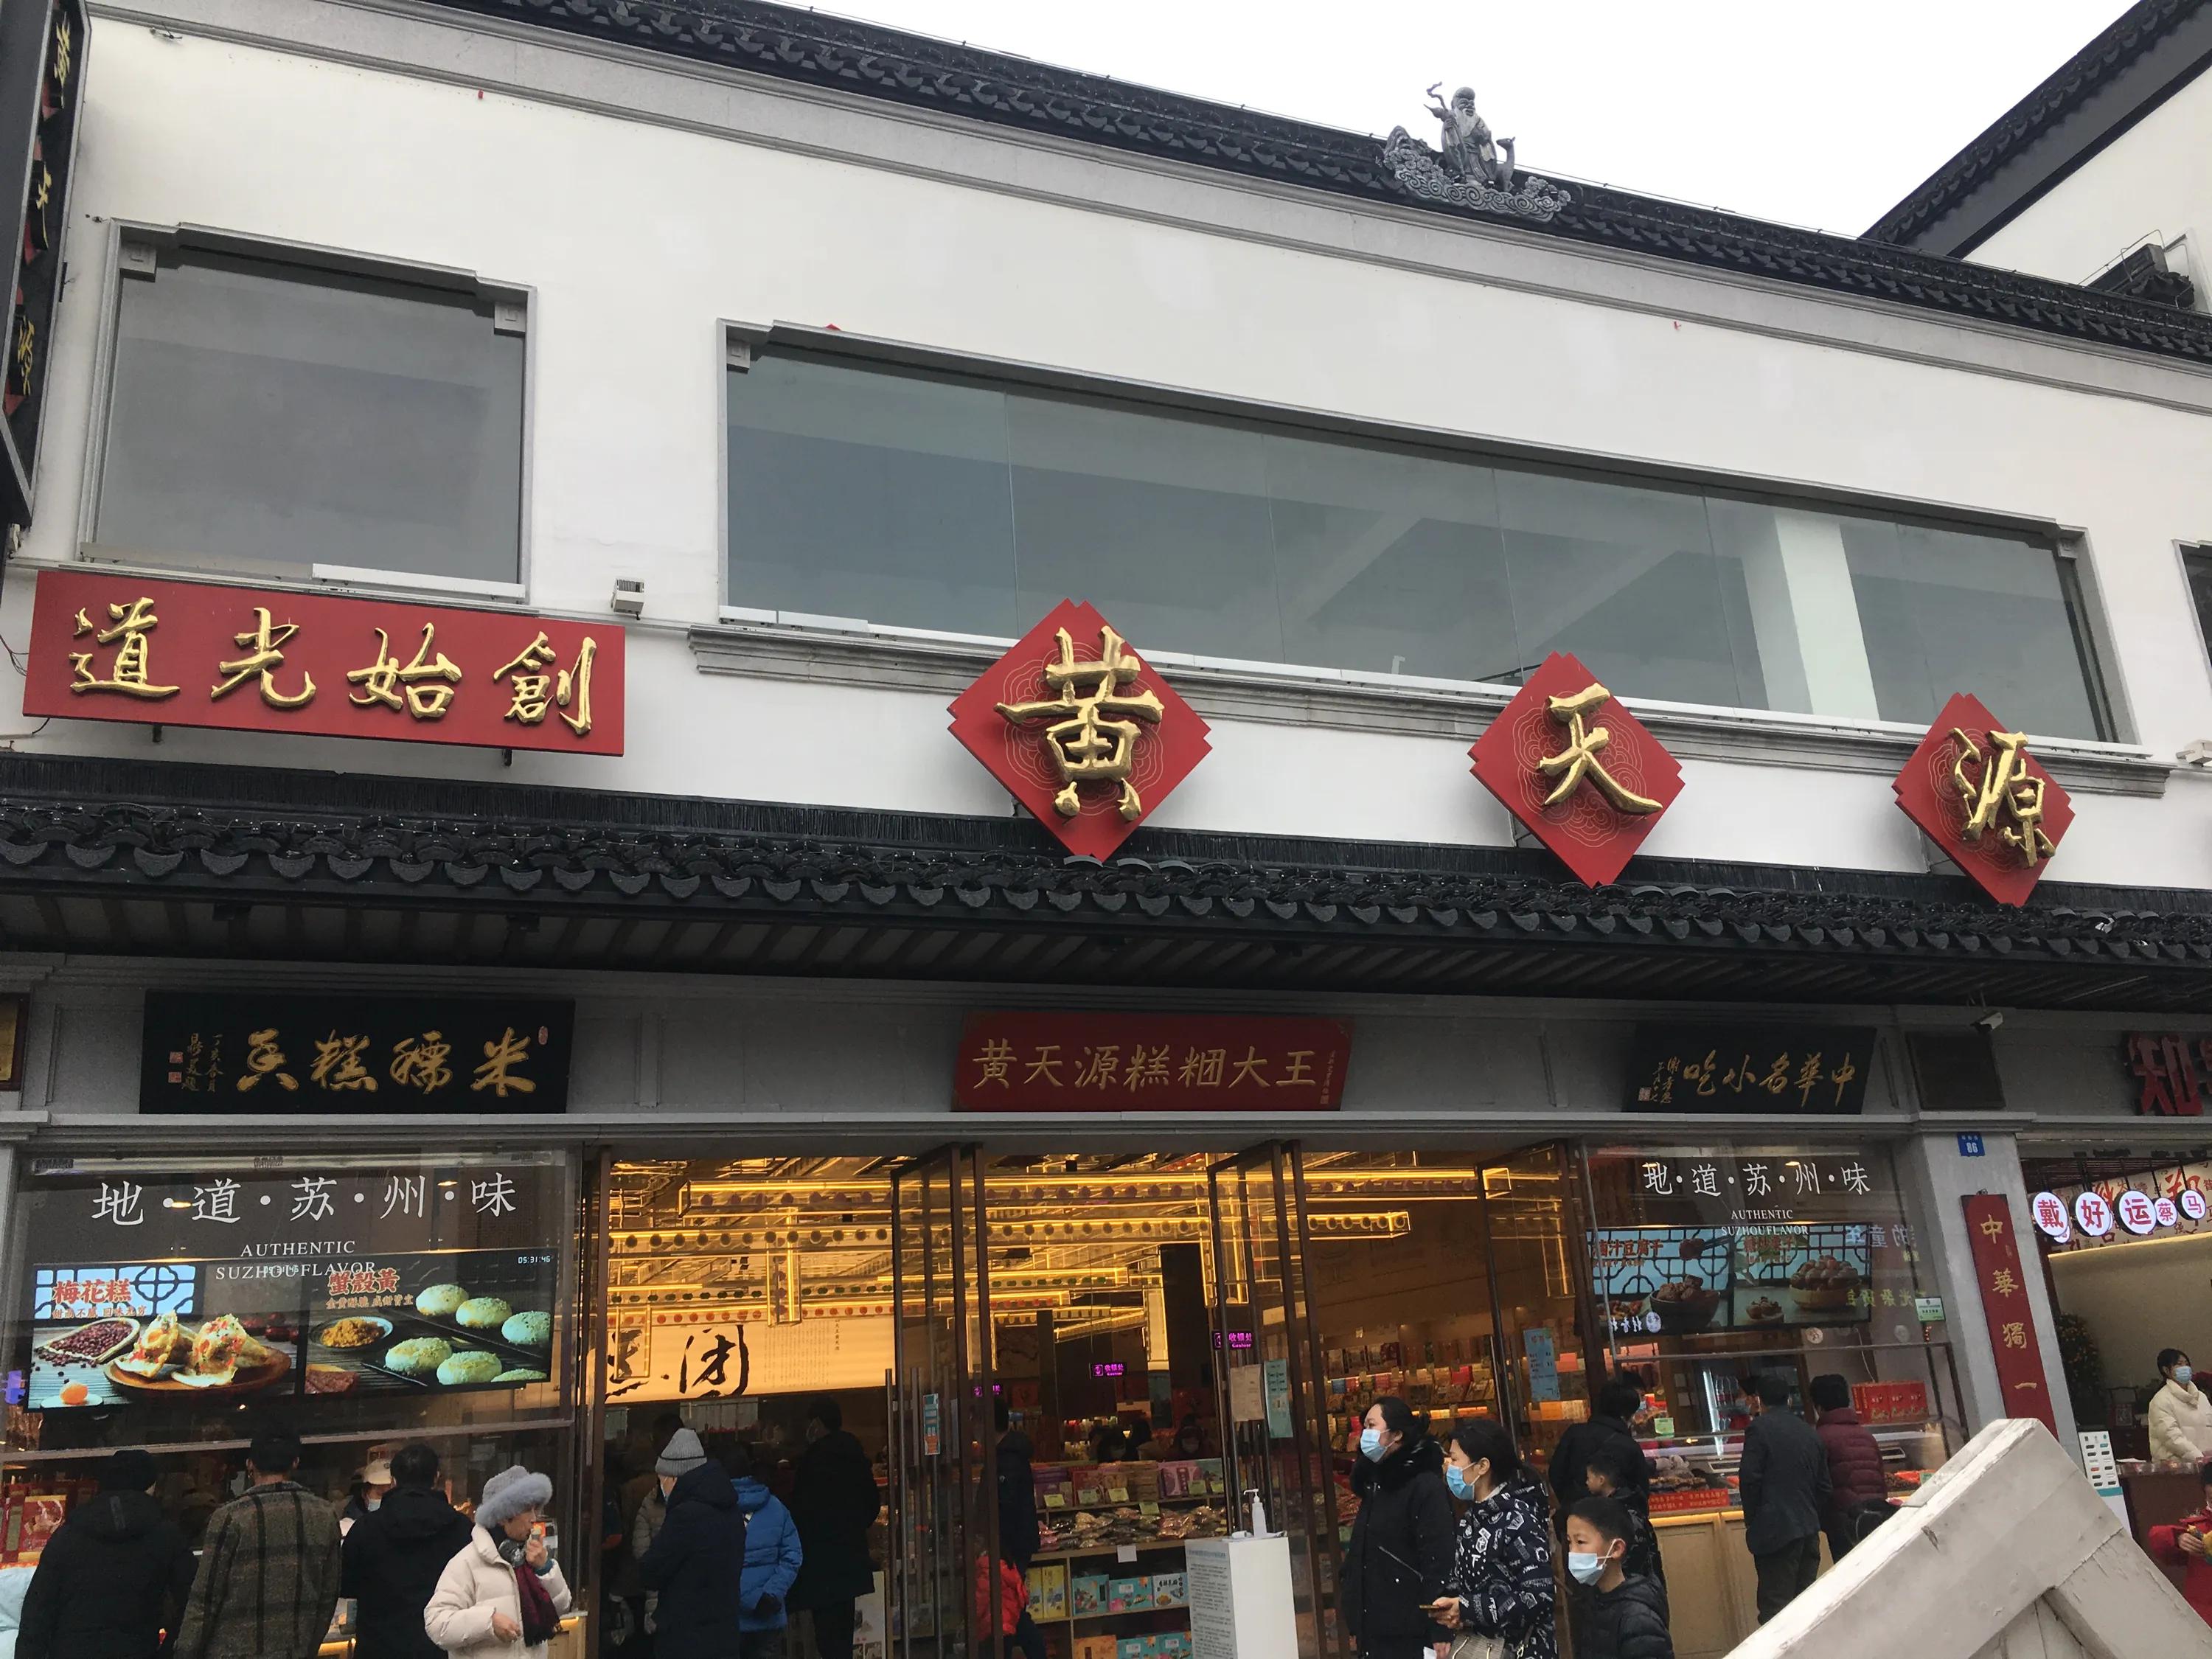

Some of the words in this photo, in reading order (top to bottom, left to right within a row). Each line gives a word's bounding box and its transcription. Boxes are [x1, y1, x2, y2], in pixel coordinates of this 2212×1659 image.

[2127, 1031, 2212, 1116] 知
[1731, 1209, 1793, 1220] AUTHENTIC
[240, 1241, 355, 1257] AUTHENTIC
[52, 1279, 133, 1304] 梅花糕
